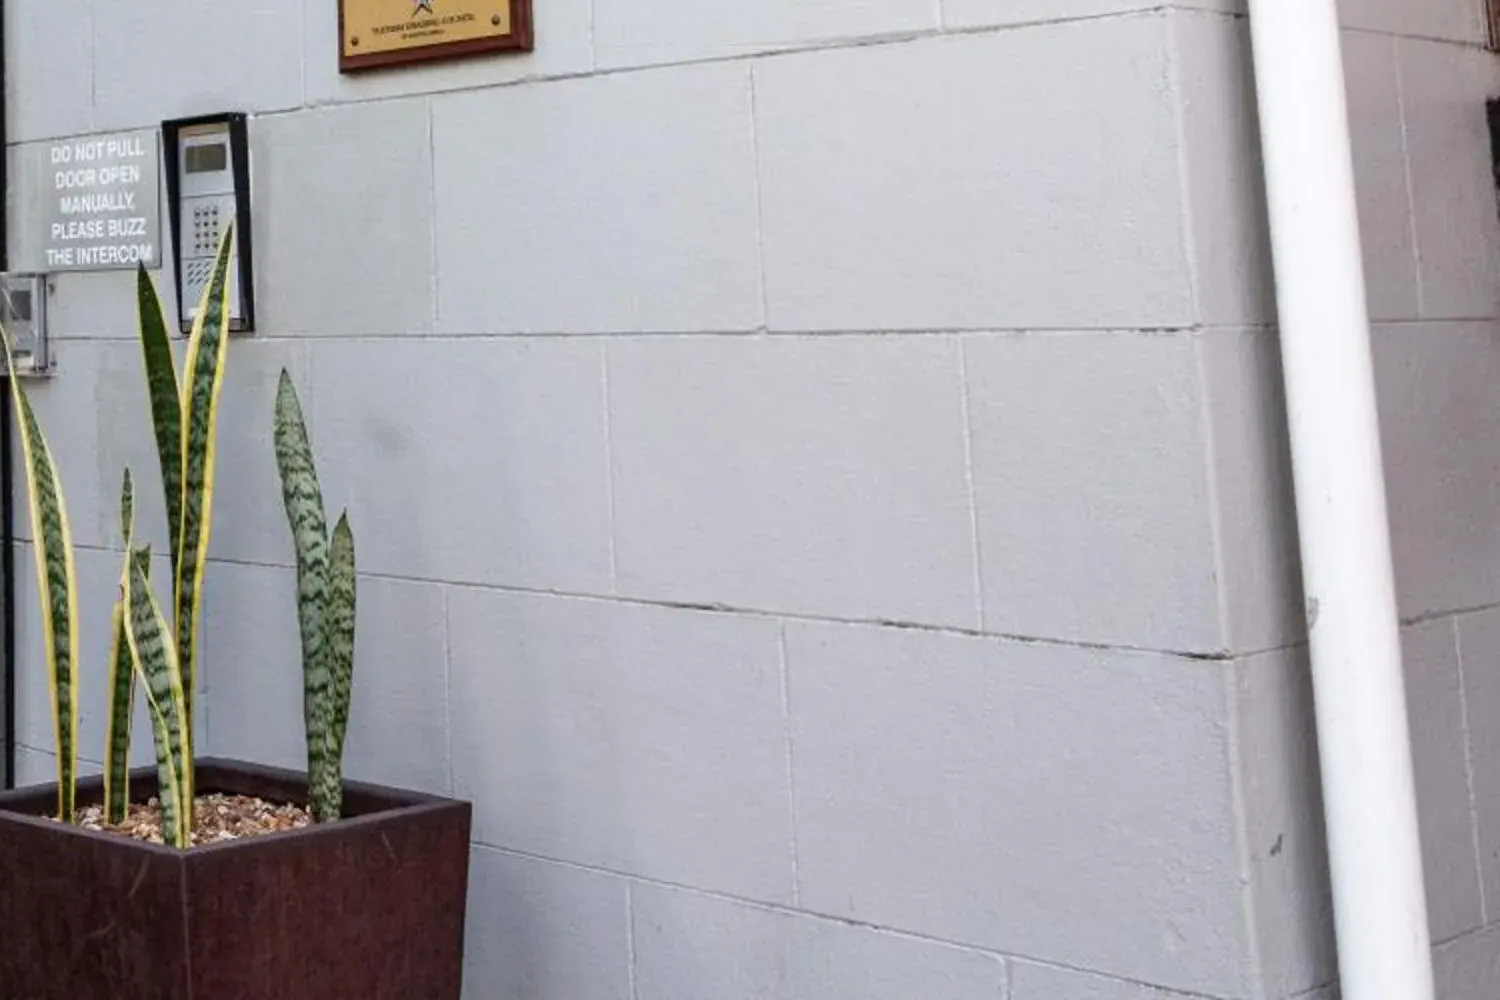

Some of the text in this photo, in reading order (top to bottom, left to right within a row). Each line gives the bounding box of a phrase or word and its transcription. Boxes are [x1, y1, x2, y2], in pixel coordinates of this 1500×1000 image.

[51, 136, 145, 164] DO NOT PULL
[55, 164, 140, 189] DOOR OPEN
[51, 217, 146, 240] PLEASE BUZZ
[45, 243, 153, 266] THE INTERCOM
